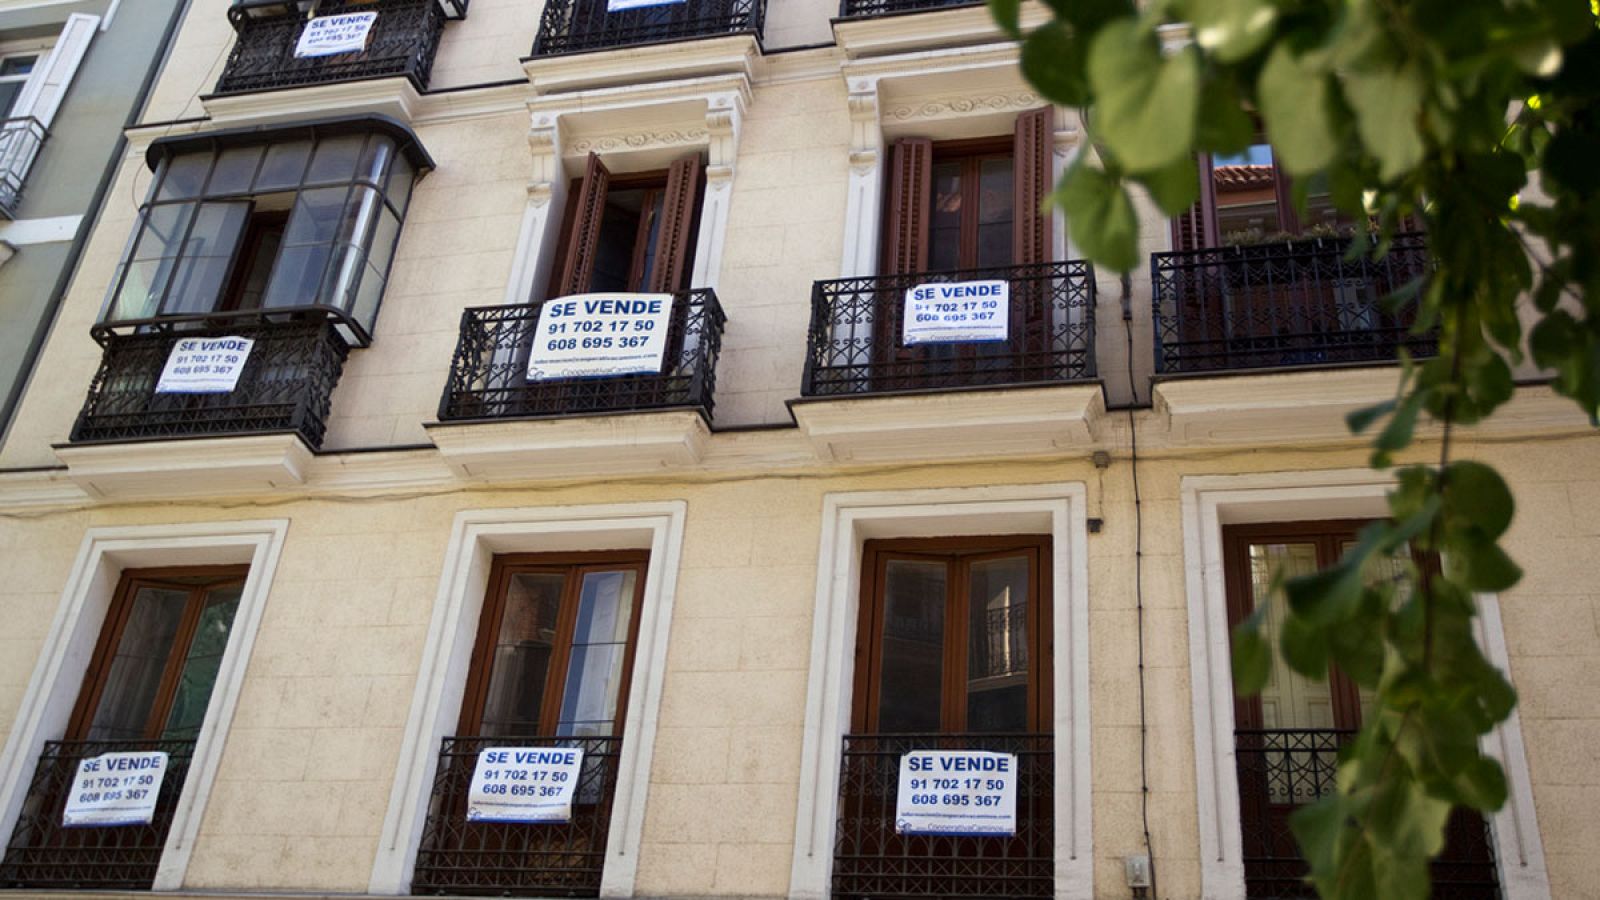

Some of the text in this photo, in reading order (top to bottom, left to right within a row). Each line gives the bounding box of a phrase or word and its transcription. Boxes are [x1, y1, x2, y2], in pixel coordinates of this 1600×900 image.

[312, 15, 371, 28] SE VENDE
[914, 284, 1001, 301] SE VENDE
[549, 300, 663, 318] SE VENDE
[935, 303, 958, 312] 702
[963, 302, 978, 311] 17
[982, 300, 997, 309] 50
[971, 311, 995, 321] 367
[548, 319, 654, 335] 91 702 17 50
[180, 340, 248, 352] SE VENDE
[547, 335, 650, 351] 608 695 367
[176, 354, 239, 364] 91 702 17 50
[212, 366, 233, 375] 367
[83, 756, 160, 773] SE VENDE
[485, 751, 576, 765] SE VENDE
[908, 756, 1009, 773] SE VENDE
[82, 775, 154, 789] 91 702 17 50
[484, 769, 568, 783] 91 702 17 50
[482, 783, 563, 797] 608 695 367
[911, 778, 1004, 790] 91 702 17 50
[80, 792, 100, 803] 608
[126, 789, 149, 800] 367
[911, 794, 1001, 807] 608 695 367
